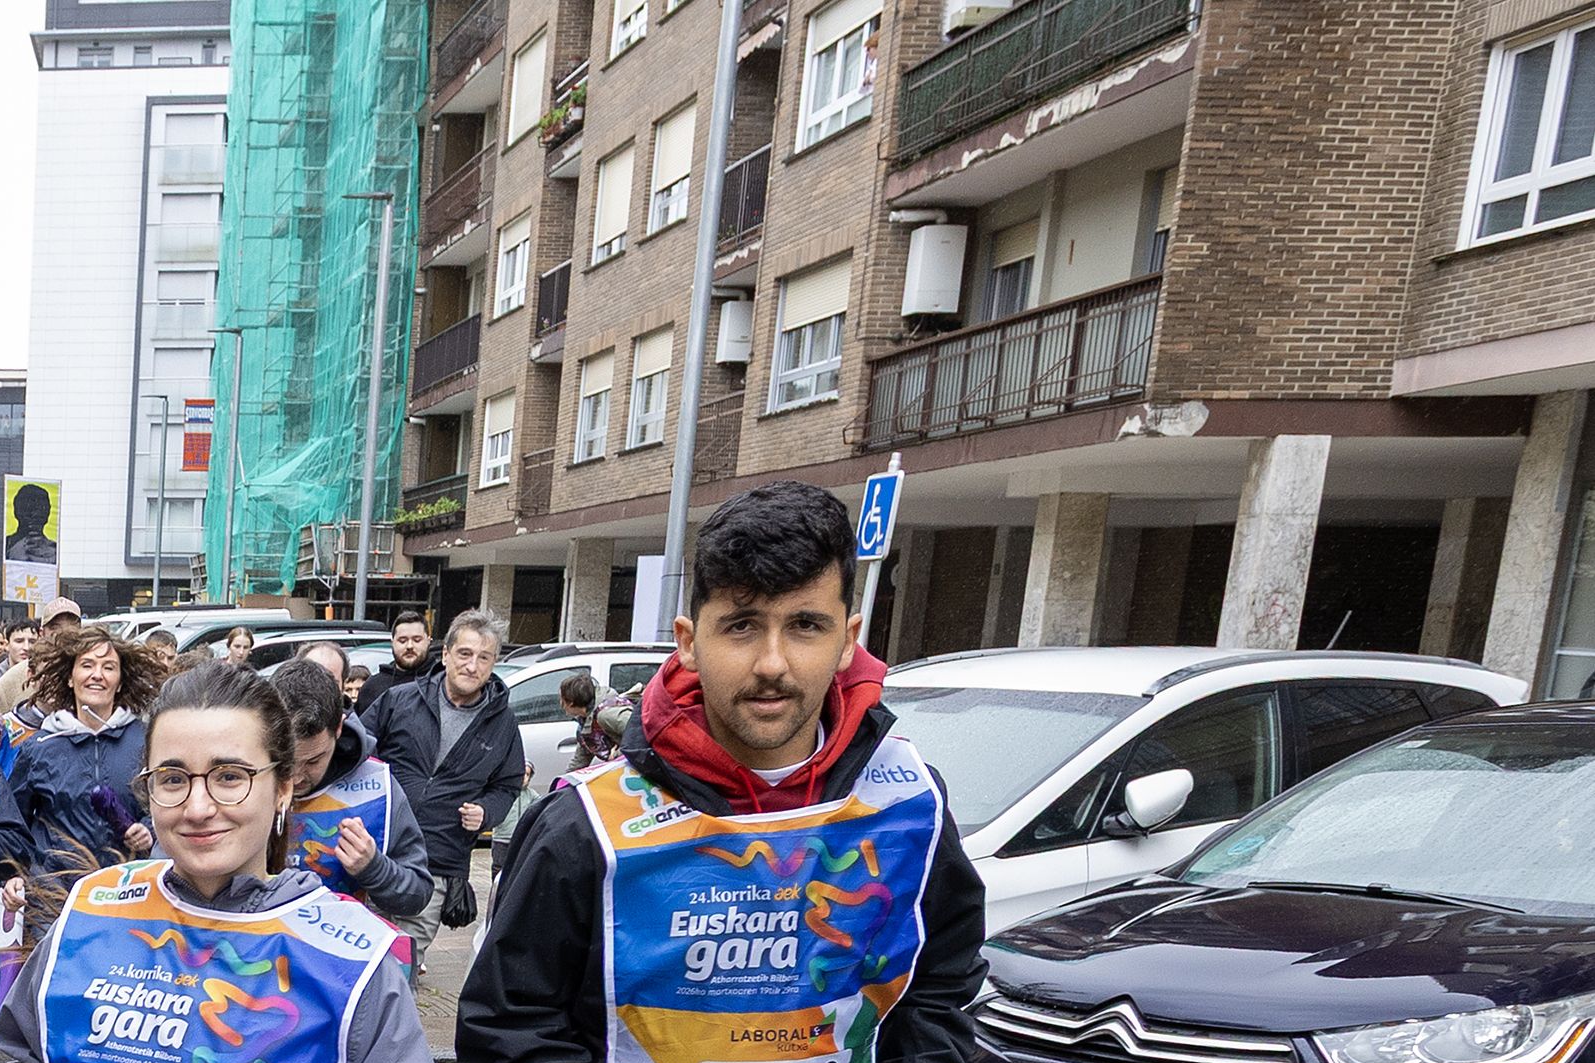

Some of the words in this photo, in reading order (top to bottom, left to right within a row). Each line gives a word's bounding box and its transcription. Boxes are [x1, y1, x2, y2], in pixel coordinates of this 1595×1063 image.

[350, 778, 382, 792] eitb
[871, 763, 920, 785] eitb
[689, 885, 771, 904] 24.korrika
[774, 882, 803, 901] aek
[669, 906, 799, 938] Euskara
[320, 922, 372, 950] eitb
[684, 936, 799, 982] gara
[108, 963, 173, 983] 24.korrika
[174, 973, 201, 988] aek
[83, 978, 194, 1016] Euskara
[87, 1005, 190, 1050] gara
[731, 1028, 808, 1043] LABORAL
[777, 1042, 809, 1053] kutxa
